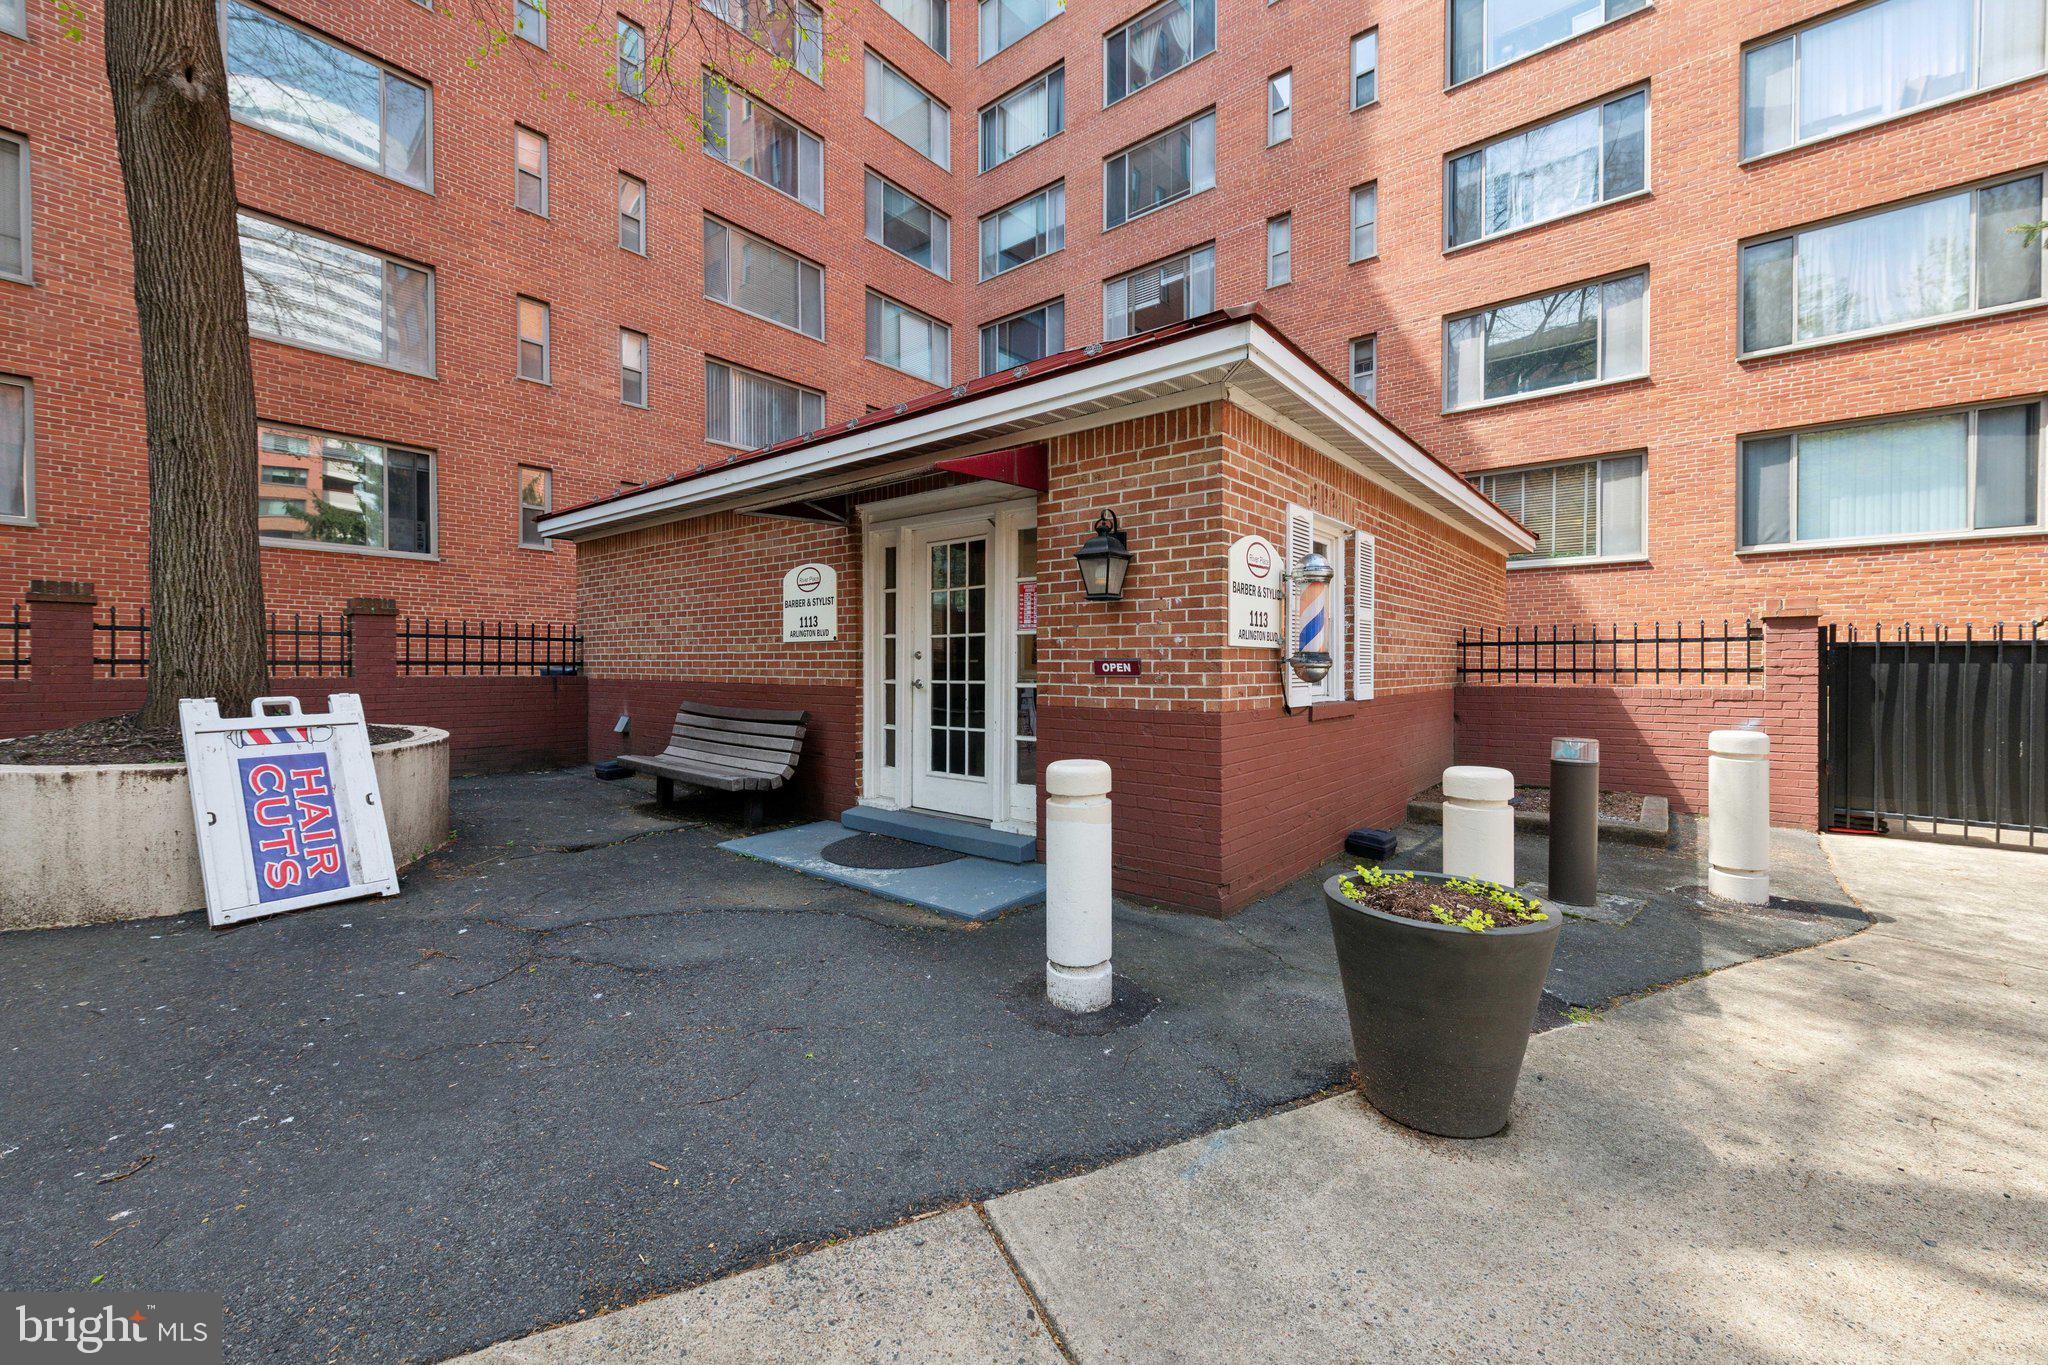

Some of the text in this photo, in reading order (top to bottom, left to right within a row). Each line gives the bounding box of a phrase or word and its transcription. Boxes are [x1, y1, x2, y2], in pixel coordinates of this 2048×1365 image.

[1232, 581, 1281, 600] BARBER & STYLIS
[785, 596, 834, 608] BARBER & STYLIST
[799, 615, 818, 628] 1113
[1249, 610, 1268, 628] 1113
[790, 628, 830, 638] ARLINGTON BLVD
[1238, 629, 1279, 642] ARLINGTON BLVD
[1102, 663, 1131, 673] OPEN
[249, 763, 302, 889] CUTS
[291, 766, 340, 879] HAIR
